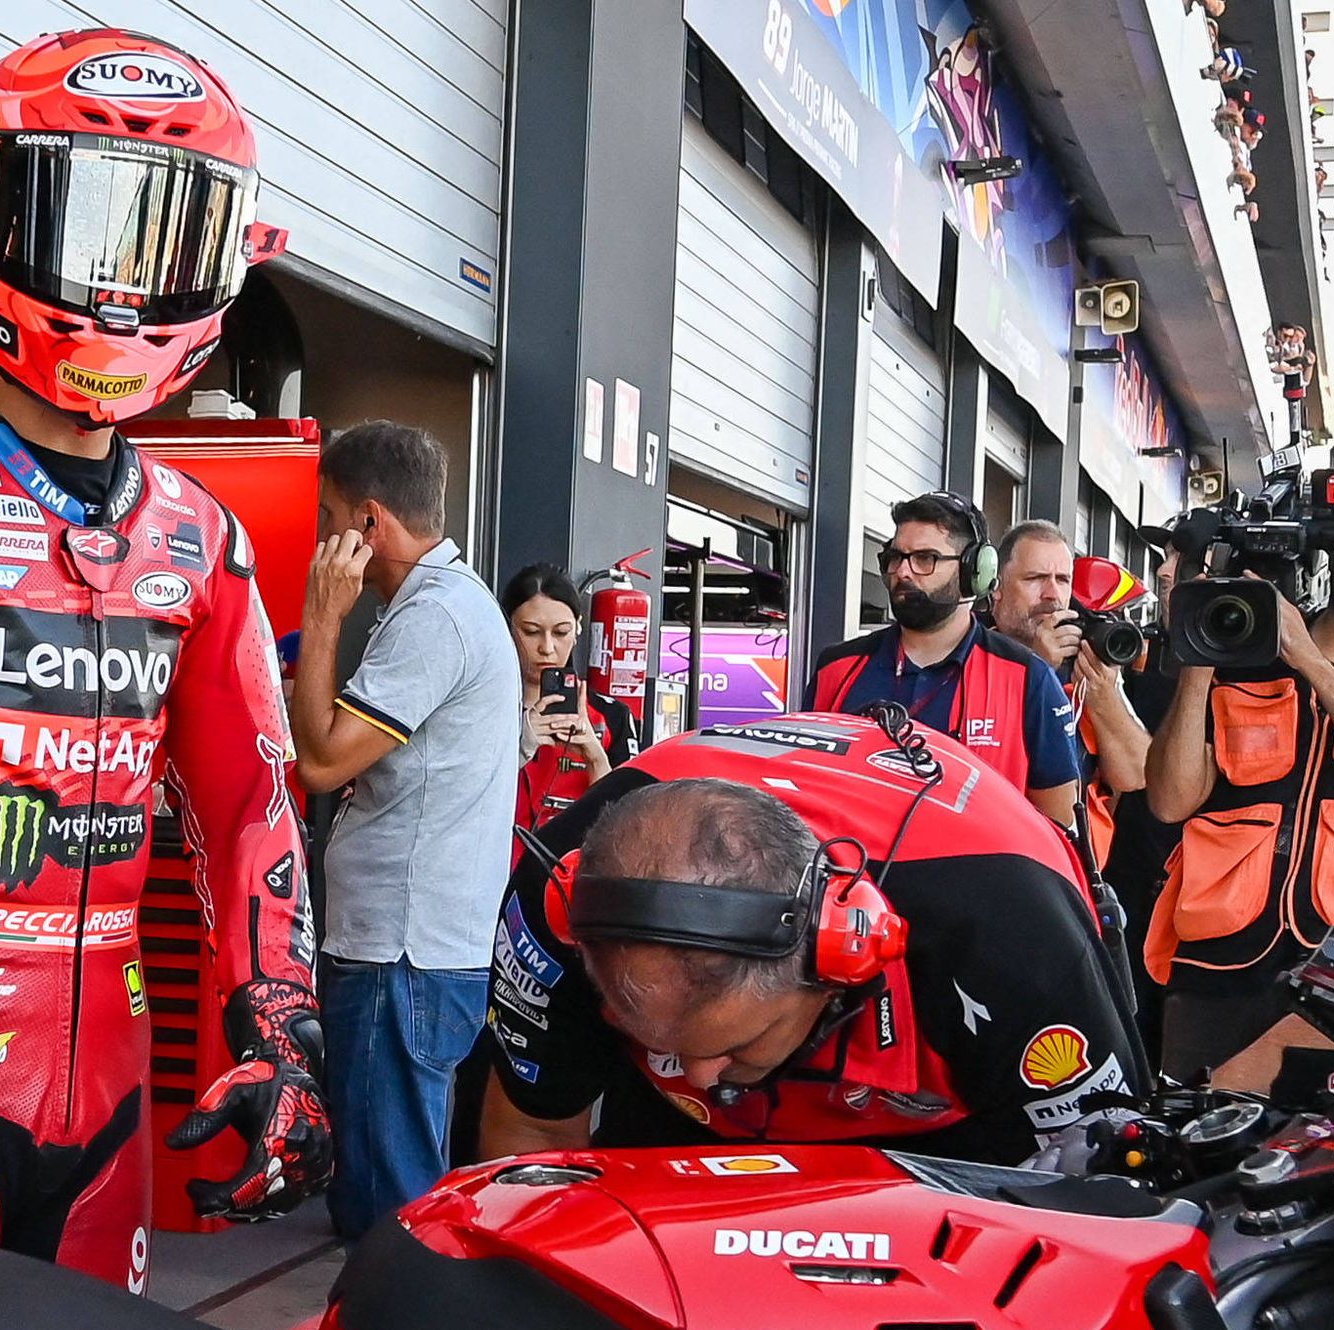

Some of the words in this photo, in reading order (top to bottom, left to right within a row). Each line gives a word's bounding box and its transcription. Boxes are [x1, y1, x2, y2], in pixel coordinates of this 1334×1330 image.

[763, 3, 793, 78] 89
[80, 62, 199, 97] SUOMY
[789, 50, 820, 126] Jorge
[816, 86, 859, 169] MARTIN
[15, 134, 69, 147] CARRERA
[113, 139, 170, 157] MONSTER
[61, 366, 145, 395] PARMACOTTO
[29, 469, 68, 513] TIM
[110, 466, 141, 523] Lenovo
[138, 582, 188, 602] SUOMY
[967, 719, 995, 736] IPF
[34, 726, 161, 779] NetAp
[47, 811, 144, 844] MONSTER
[503, 948, 546, 999] riello
[516, 930, 549, 975] TIM
[881, 996, 894, 1047] Lenovo
[1057, 1067, 1118, 1116] NeApp
[713, 1229, 891, 1261] DUCATI
